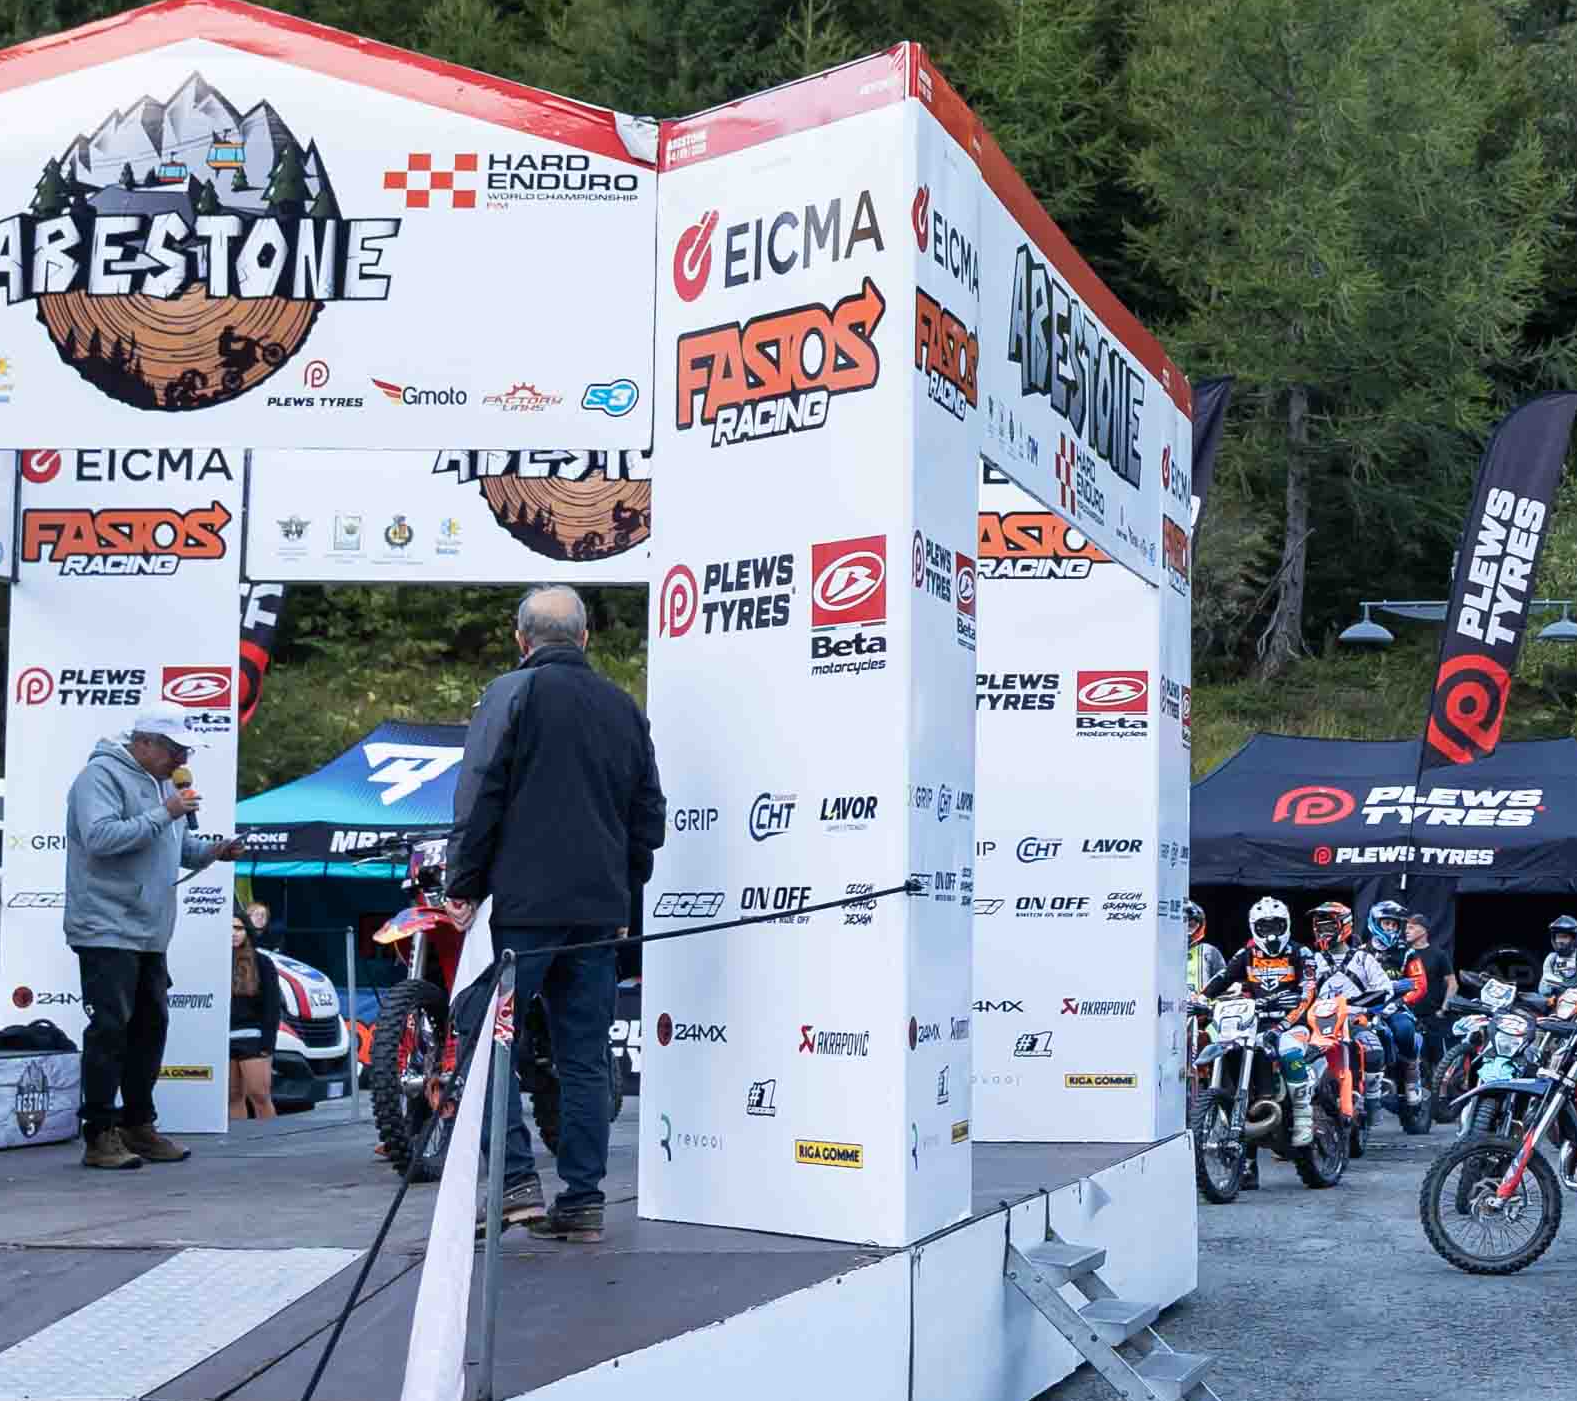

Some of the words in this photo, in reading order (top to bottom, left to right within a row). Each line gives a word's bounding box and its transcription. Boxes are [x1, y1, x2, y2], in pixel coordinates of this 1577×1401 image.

[487, 152, 591, 172] HARD
[486, 173, 639, 192] ENDURO
[486, 192, 535, 202] WORLD
[536, 192, 639, 202] CHAMPIONSHIP
[724, 189, 885, 288] EICMA
[932, 209, 981, 303] EICMA
[1007, 243, 1145, 490] ABESTONE
[267, 396, 314, 408] PLEWS
[319, 396, 364, 408] TYRES
[401, 386, 468, 407] Gmoto
[585, 382, 637, 413] S3
[928, 370, 968, 423] RACING
[711, 390, 831, 448] RACING
[75, 448, 234, 481] EICMA
[59, 553, 181, 576] RACING
[925, 538, 952, 574] PLEWS
[1456, 486, 1516, 640] PLEWS
[703, 553, 795, 595] PLEWS
[978, 556, 1094, 580] RACING
[1485, 496, 1547, 647] TYRES
[925, 570, 952, 604] TYRES
[702, 593, 791, 635] TYRES
[810, 632, 887, 660] Beta
[59, 669, 146, 686] PLEWS
[811, 658, 887, 677] motorcycles
[975, 673, 1060, 690] PLEWS
[58, 688, 141, 706] TYRES
[975, 693, 1057, 711] TYRES
[1076, 716, 1148, 729] Beta
[1076, 730, 1148, 739] motorcycles
[1365, 784, 1544, 808] PLEWS
[820, 795, 879, 822] LAVOR
[1360, 806, 1535, 828] TYRES
[1081, 838, 1144, 854] LAVOR
[1335, 845, 1416, 865] PLEWS
[1420, 846, 1495, 866] TYRES
[740, 886, 772, 911] ON
[773, 885, 812, 911] OFF
[1015, 896, 1047, 911] ON
[1050, 896, 1091, 911] OFF
[36, 991, 82, 1005] 24M
[674, 1022, 728, 1043] 24MX
[1068, 1076, 1093, 1086] RIGA
[1094, 1075, 1134, 1086] GOMME
[798, 1144, 821, 1160] RIGA
[822, 1146, 861, 1163] GOMME
